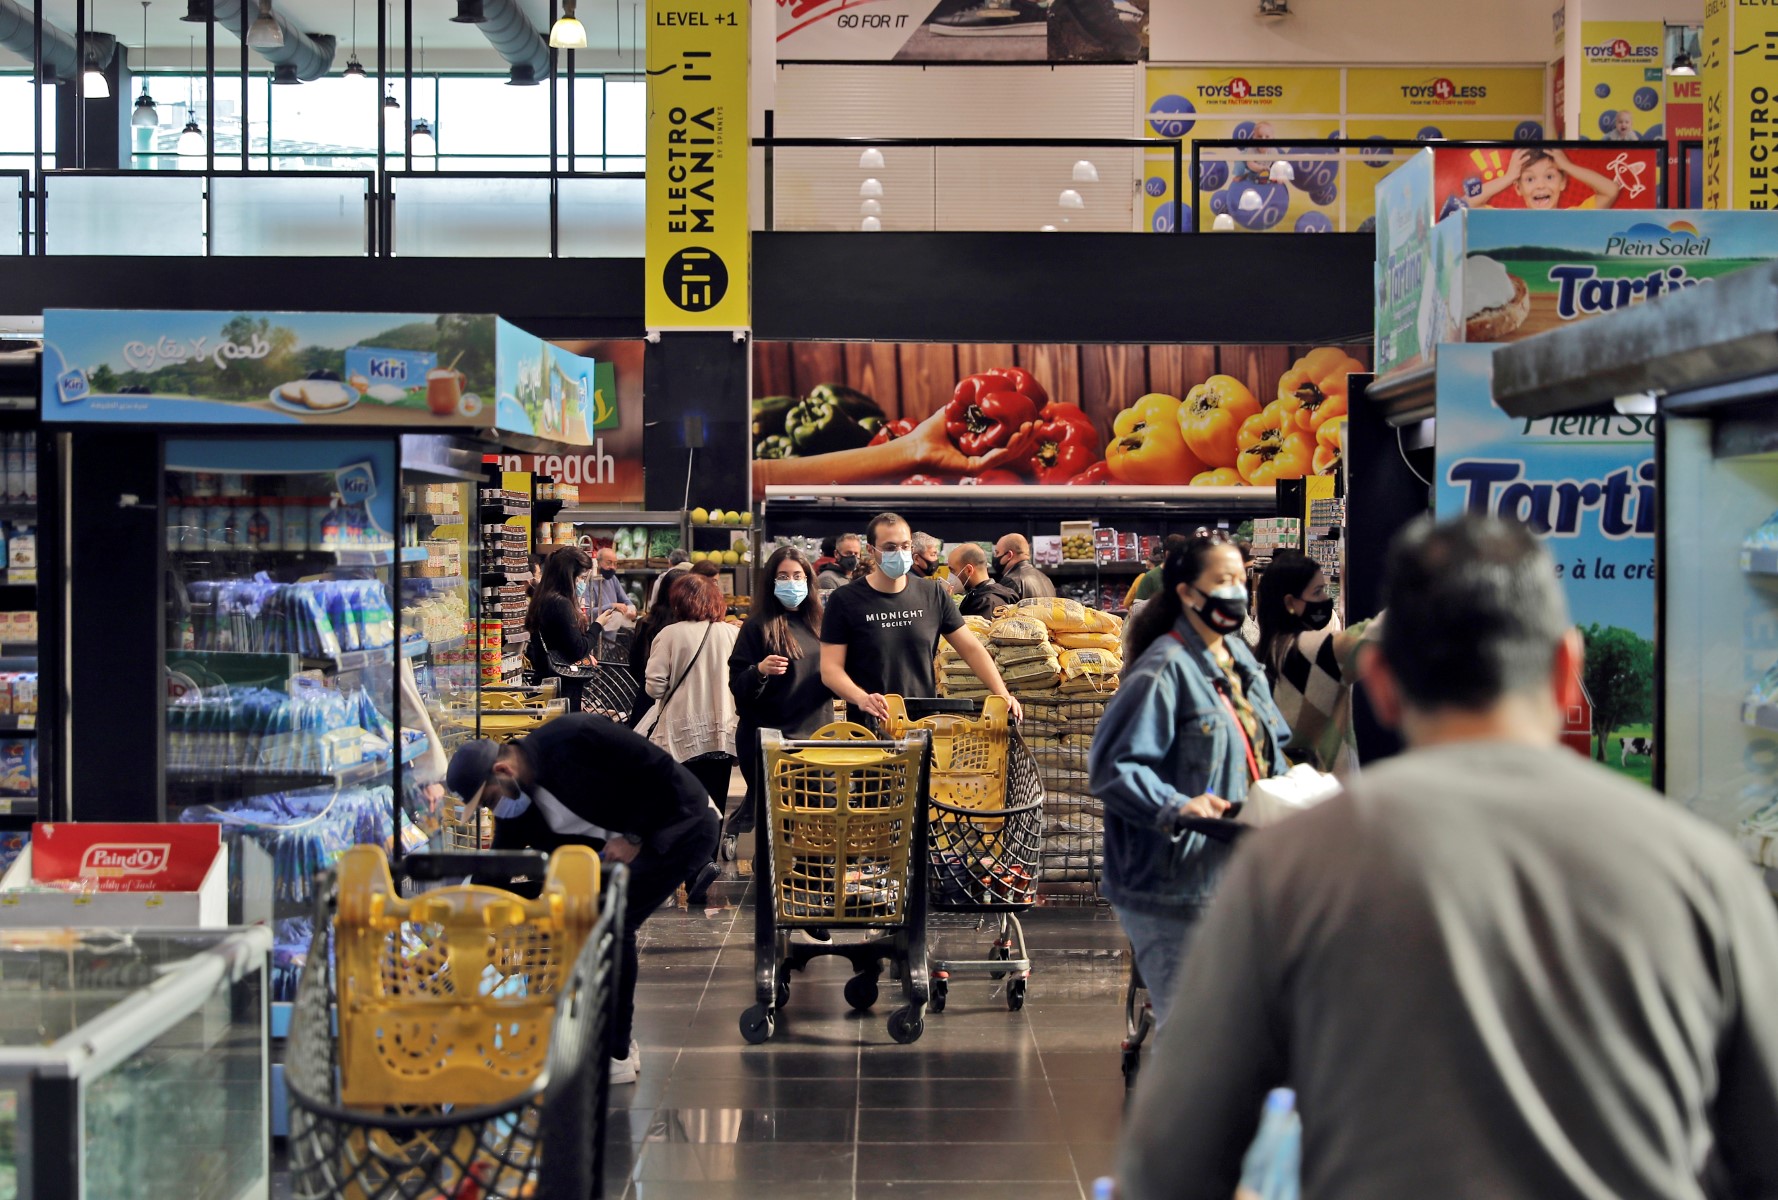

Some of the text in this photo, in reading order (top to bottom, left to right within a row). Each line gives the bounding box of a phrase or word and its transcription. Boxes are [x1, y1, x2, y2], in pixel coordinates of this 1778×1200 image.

[656, 11, 738, 26] LEVEL +1
[837, 14, 909, 28] GO FOR IT
[717, 149, 723, 158] BY
[668, 107, 687, 232] ELECTRO
[690, 107, 715, 232] MANIA
[1605, 237, 1711, 256] Plein Soleil
[188, 335, 207, 363] لا
[213, 333, 271, 370] طعم
[370, 358, 406, 379] Kiri
[64, 378, 84, 391] Kiri
[533, 437, 615, 485] reach
[344, 478, 369, 493] Kiri
[1572, 558, 1587, 579] à
[1594, 557, 1616, 579] la
[865, 609, 924, 622] MIDNIGHT
[881, 620, 912, 628] SOCIETY
